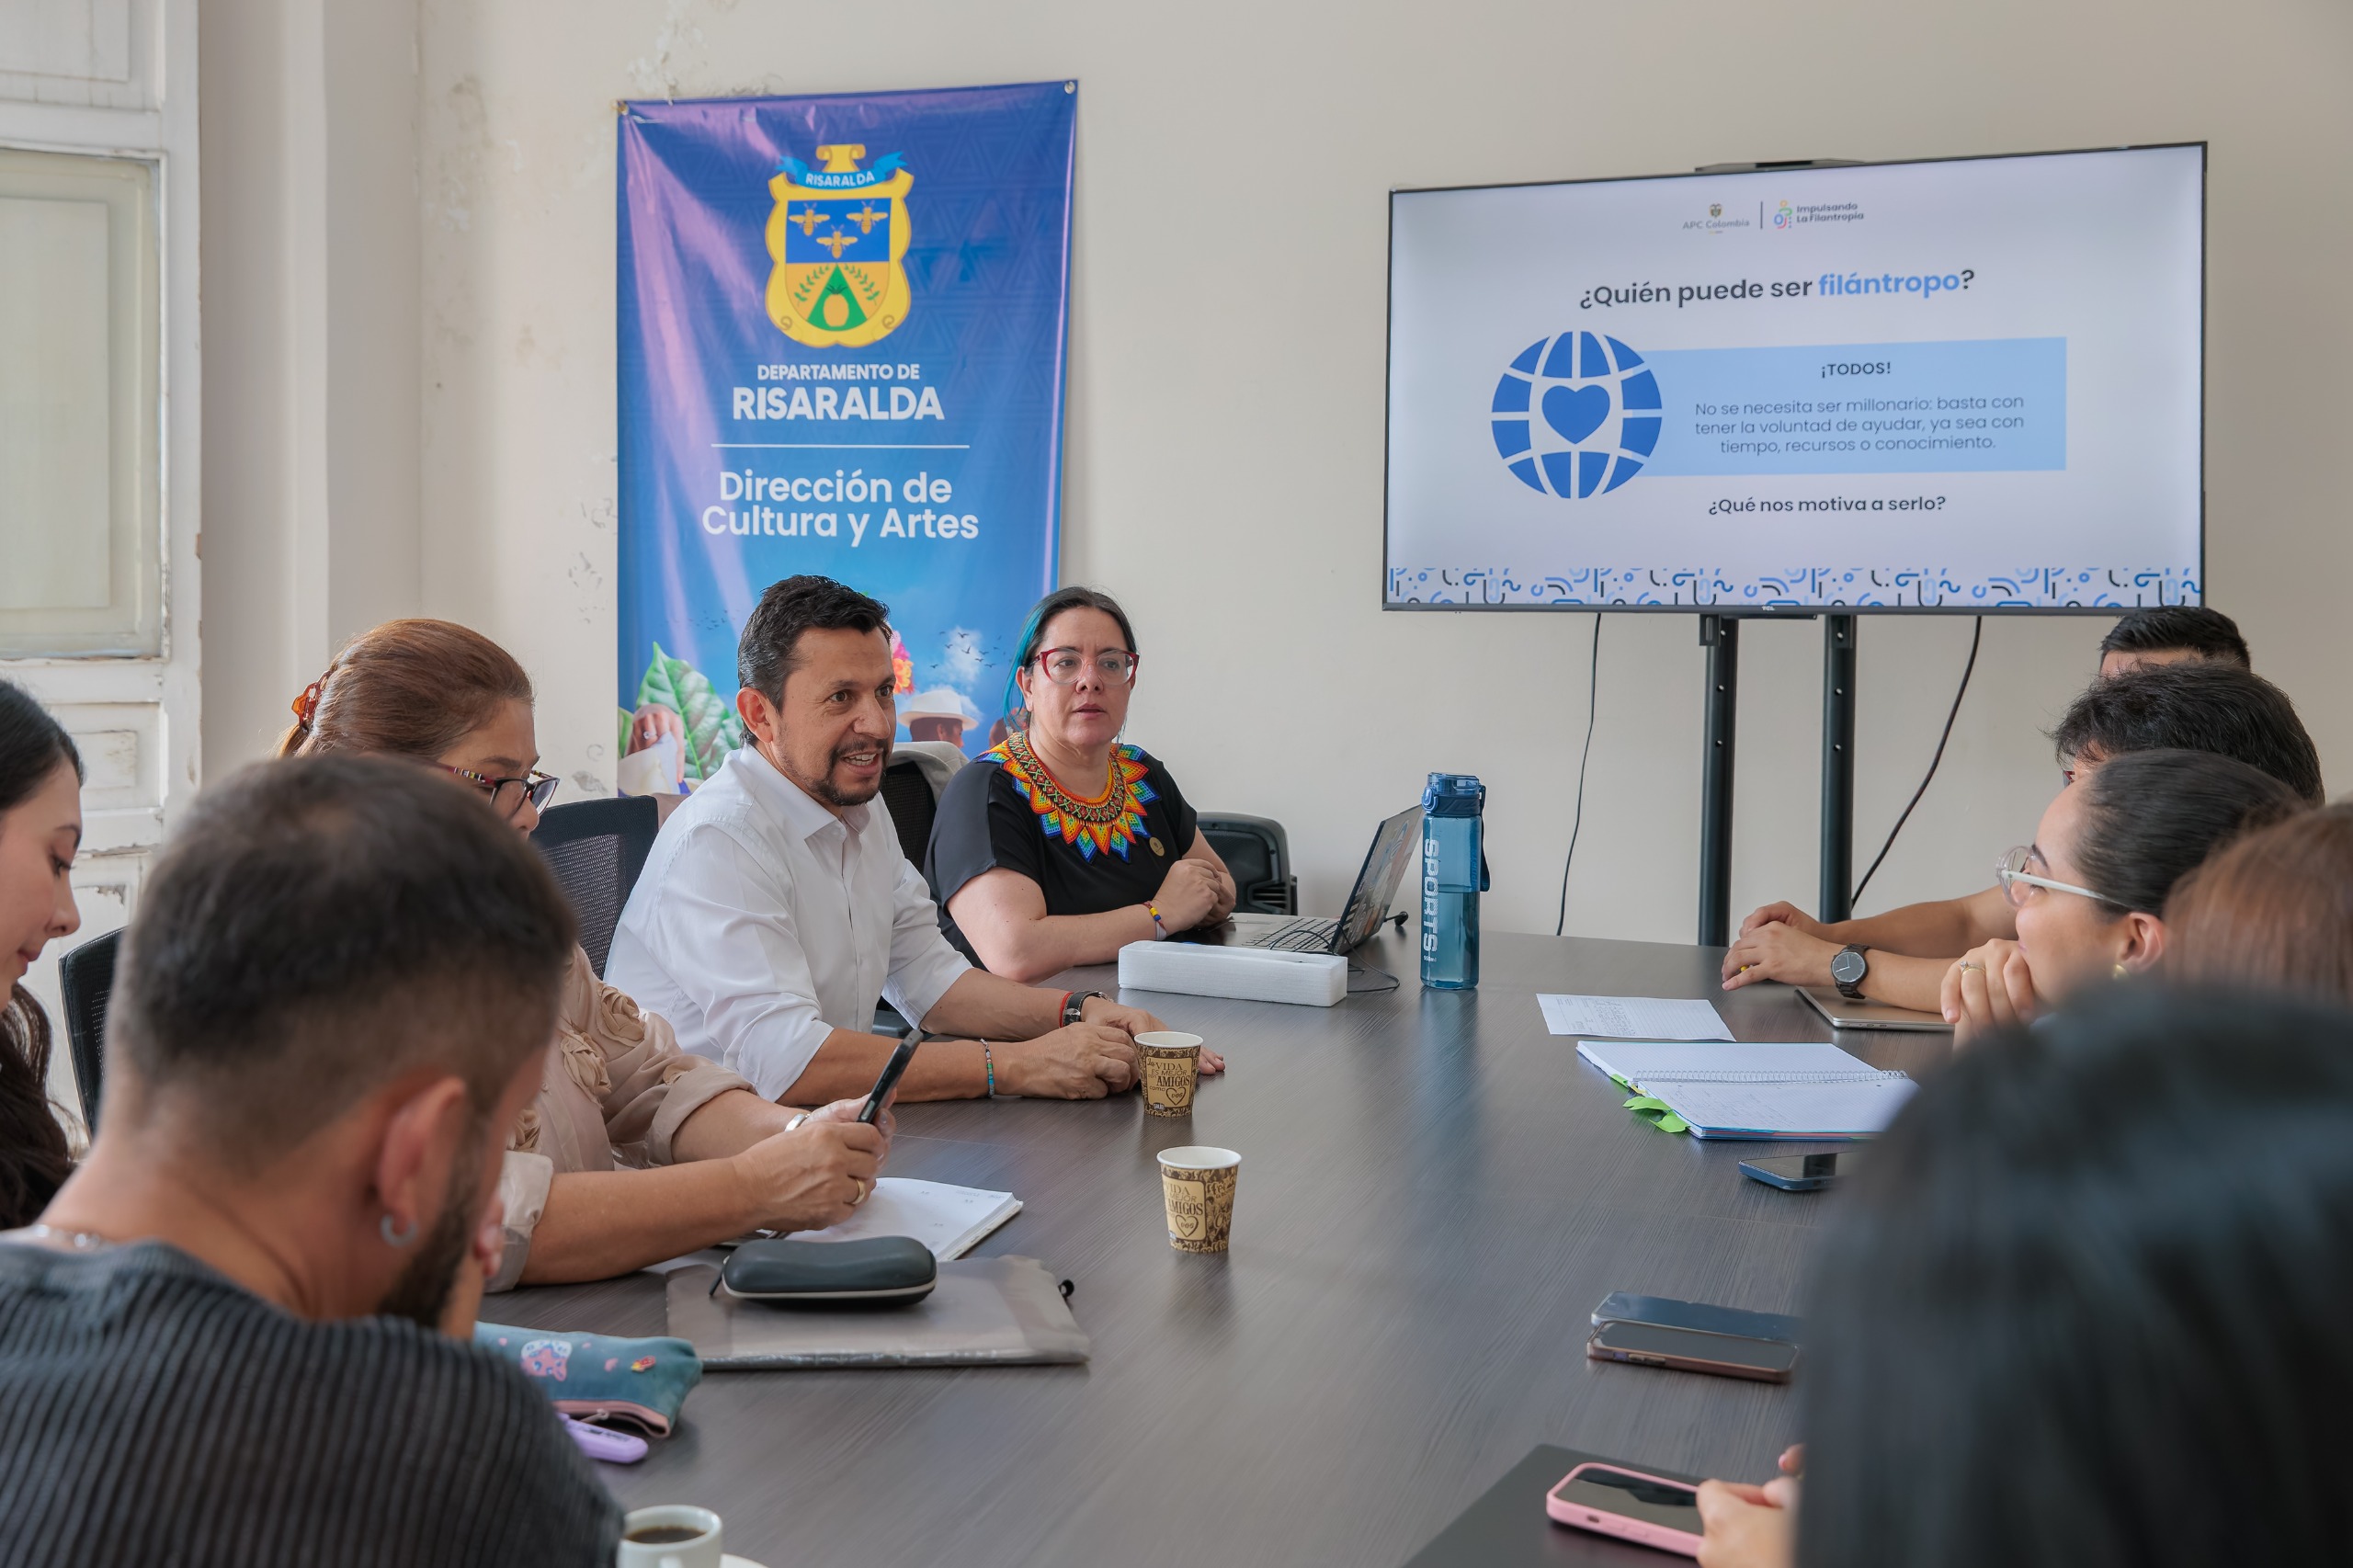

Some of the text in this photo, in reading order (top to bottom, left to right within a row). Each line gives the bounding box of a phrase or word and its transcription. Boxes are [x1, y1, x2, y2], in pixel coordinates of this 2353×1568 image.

[805, 171, 875, 187] RISARALDA
[1796, 202, 1858, 214] Impulsando
[1682, 219, 1750, 230] APC Colombia
[1796, 215, 1808, 223] La
[1579, 269, 1975, 310] ¿Quién puede ser filántropo?
[756, 364, 920, 381] DEPARTAMENTO DE
[1821, 362, 1892, 379] ¡TODOS!
[733, 386, 946, 420] RISARALDA
[1695, 396, 2024, 416] No se necesita ser millonario: basta con
[1695, 415, 2024, 436] tener la voluntad de ayudar, ya sea con
[1721, 436, 1995, 456] tiempo, recursos o conocimiento.
[720, 469, 952, 504] Dirección de
[1709, 495, 1947, 516] ¿Qué nos motiva a serlo?
[701, 505, 979, 548] Cultura y Artes
[1424, 838, 1438, 952] SPORTS
[1155, 1062, 1183, 1071] VIDA
[1155, 1075, 1190, 1087] AMIGOS
[1167, 1198, 1203, 1215] AMIGOS
